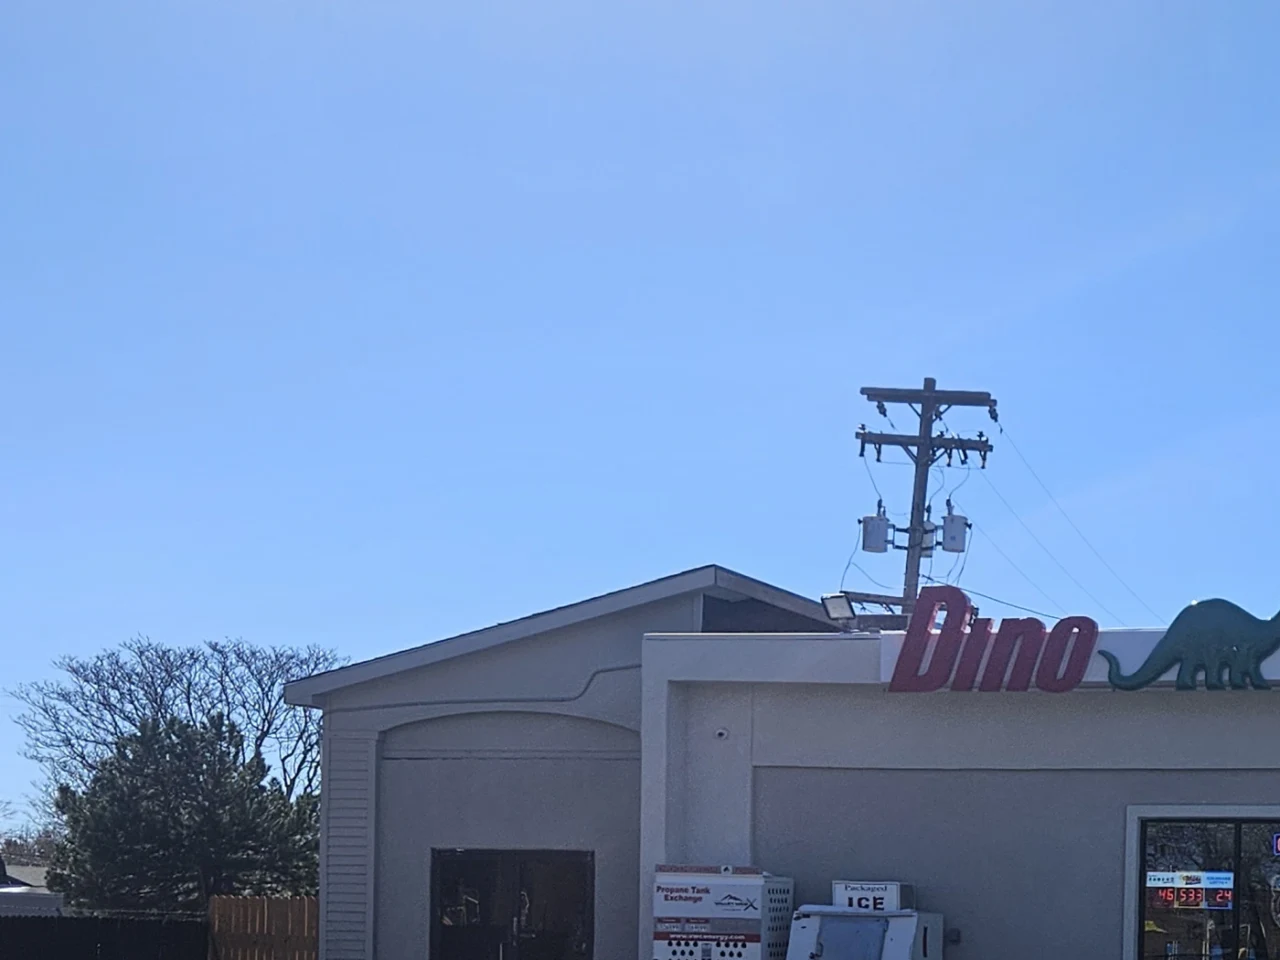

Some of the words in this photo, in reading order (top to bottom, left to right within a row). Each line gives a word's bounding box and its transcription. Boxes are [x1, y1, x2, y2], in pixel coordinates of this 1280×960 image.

[888, 585, 1100, 692] Dino
[656, 886, 689, 894] Propane
[691, 886, 710, 894] Tank
[844, 884, 887, 892] Packaged
[664, 894, 702, 903] Exchange
[1216, 889, 1232, 902] 24
[848, 896, 884, 911] ICE
